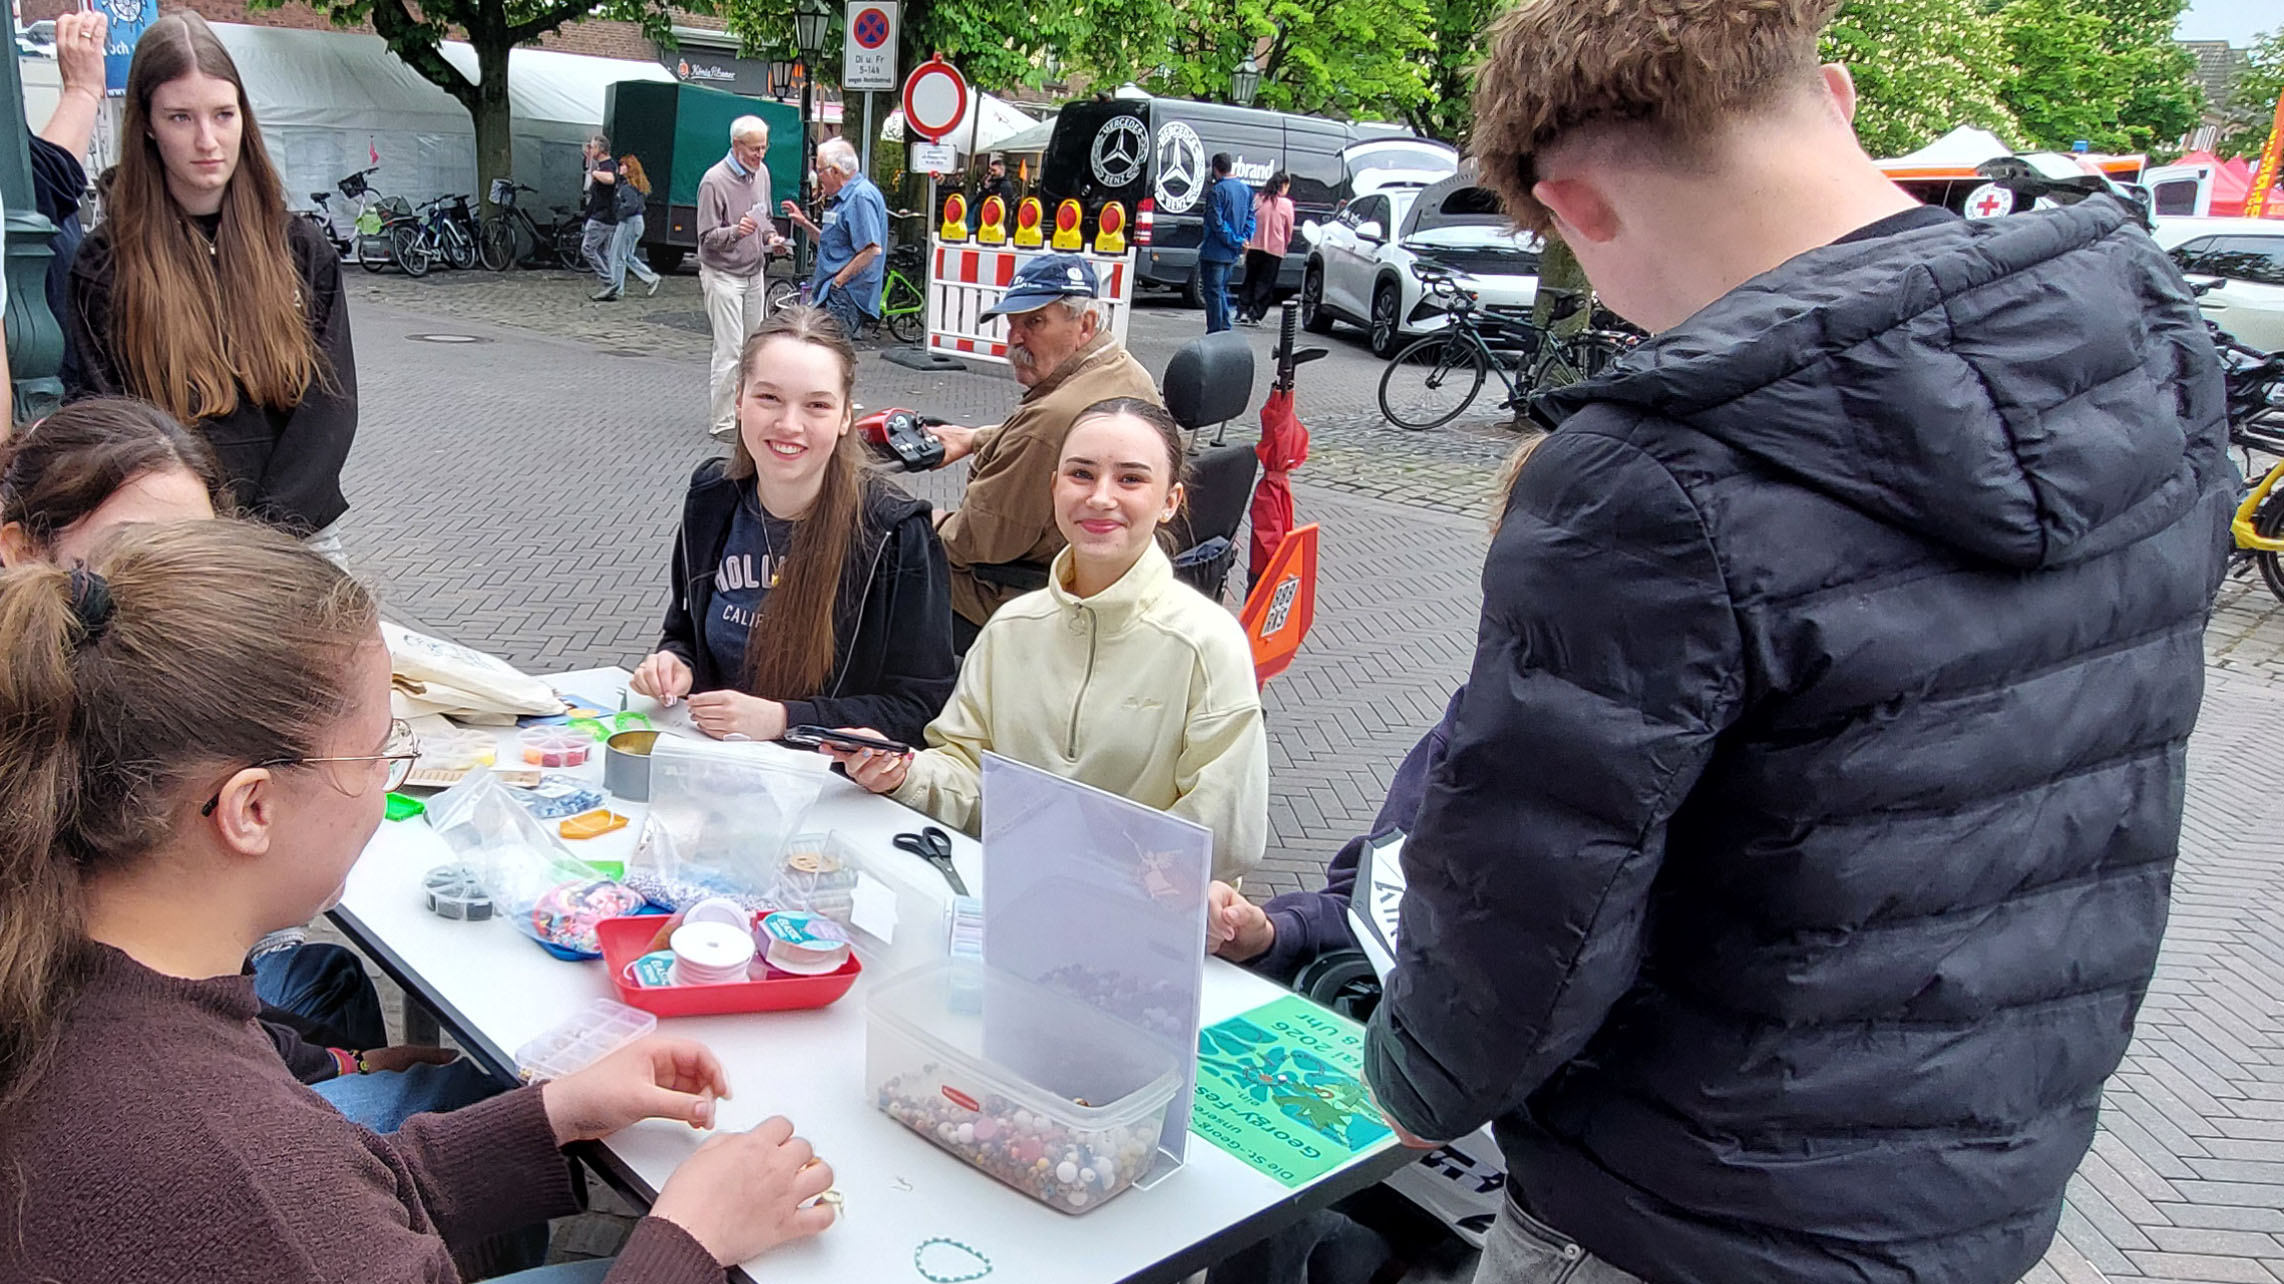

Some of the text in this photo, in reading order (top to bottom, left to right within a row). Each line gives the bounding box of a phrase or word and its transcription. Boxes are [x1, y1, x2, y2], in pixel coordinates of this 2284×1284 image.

[876, 55, 885, 64] Fr
[1102, 117, 1143, 135] MERCEDES
[1158, 125, 1198, 145] MERCEDES
[1104, 174, 1126, 184] BENZ
[1231, 155, 1275, 180] rbrand
[1165, 198, 1188, 211] BENZ
[722, 604, 765, 628] CALIF
[1271, 1021, 1333, 1051] 2026
[1295, 1013, 1339, 1036] Uhr
[1193, 1103, 1242, 1134] unsere
[1195, 1083, 1321, 1158] Georgy-Fes
[1192, 1117, 1294, 1180] Die St.-Georg-
